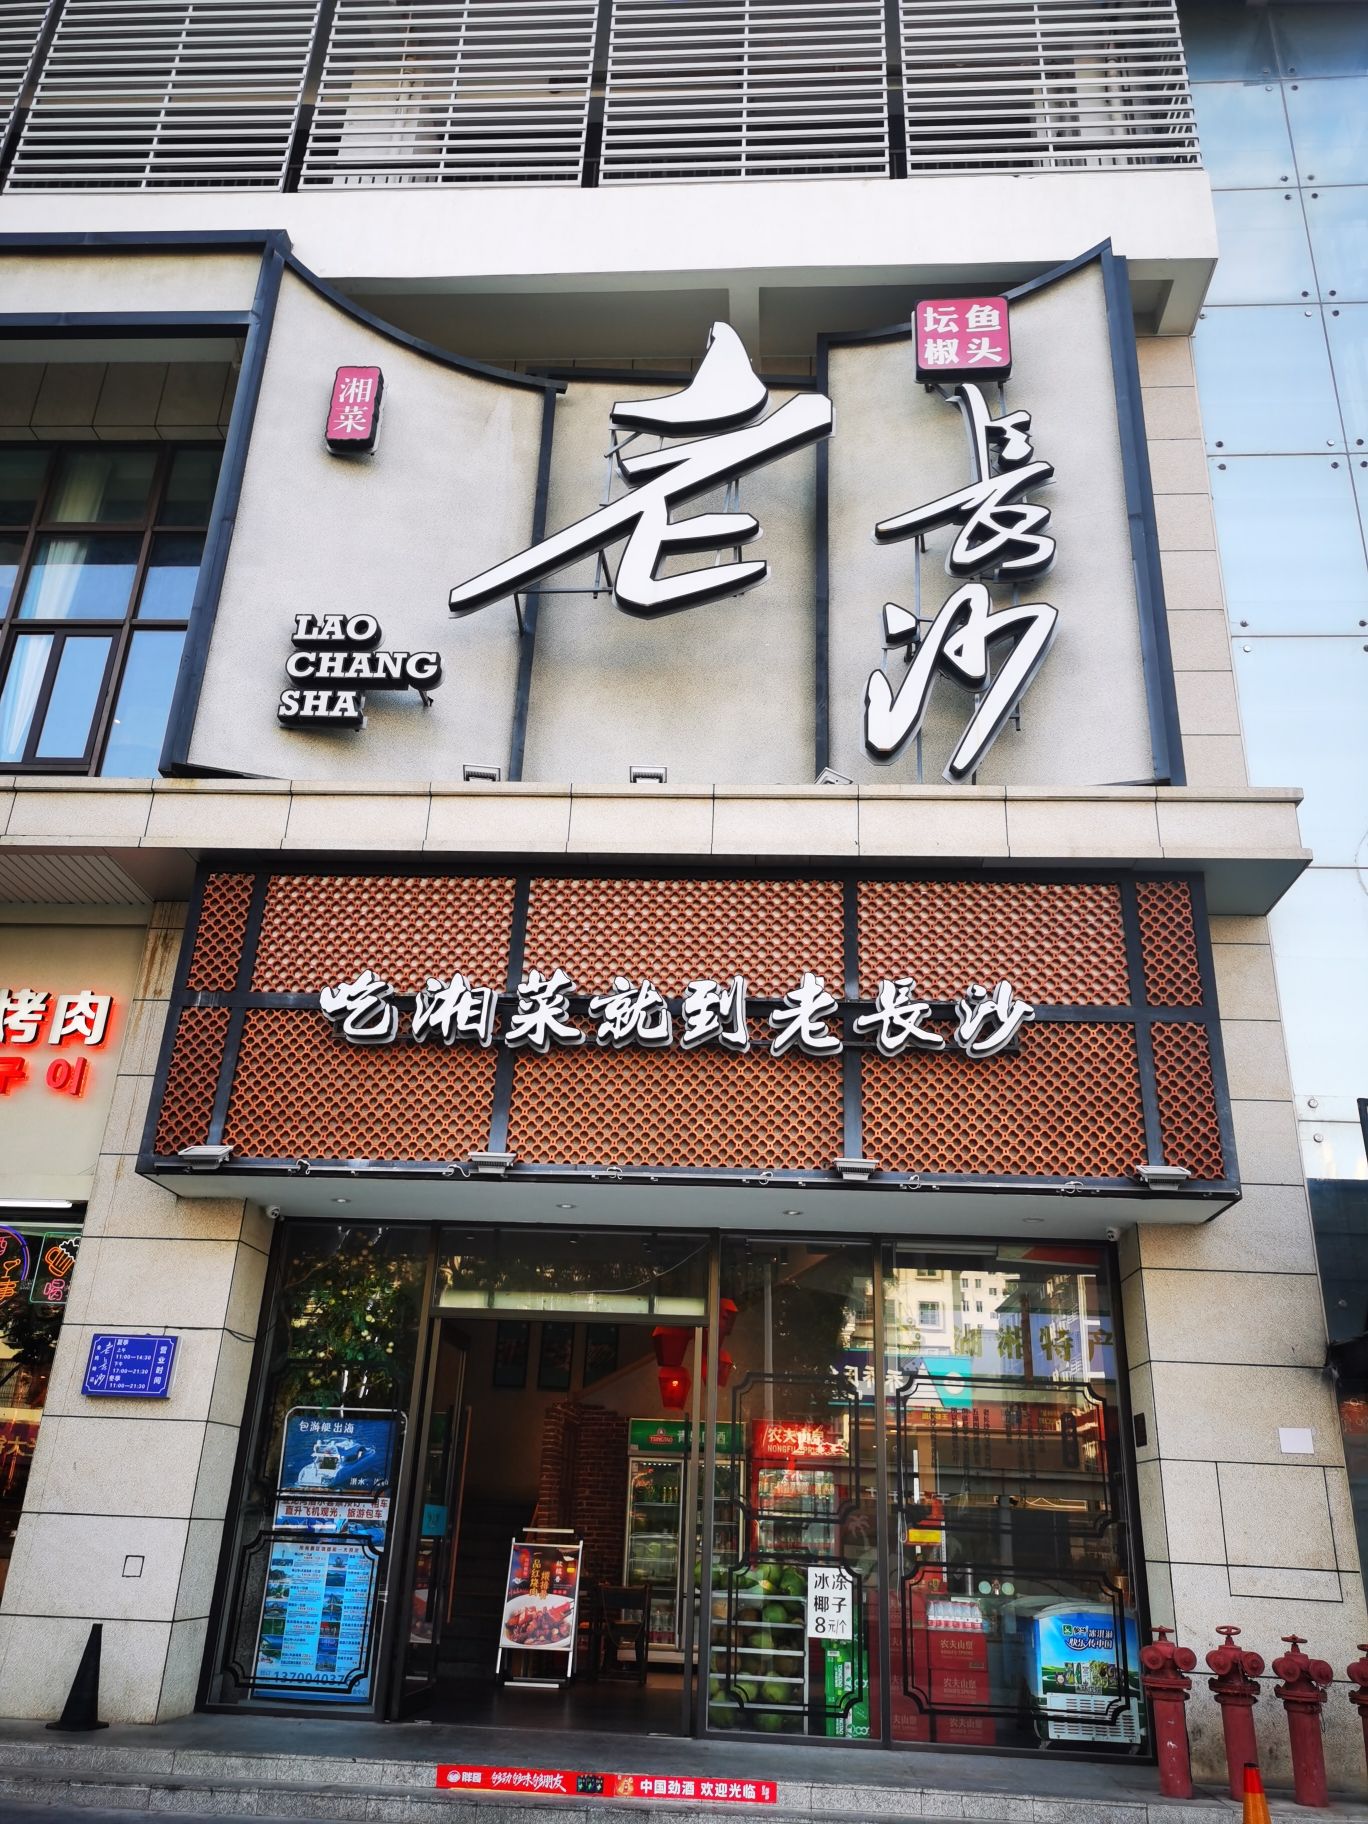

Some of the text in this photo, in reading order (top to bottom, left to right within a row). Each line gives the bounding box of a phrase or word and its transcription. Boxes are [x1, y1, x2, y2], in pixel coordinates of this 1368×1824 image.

[332, 377, 373, 434] 湘菜
[293, 613, 378, 641] LAO
[285, 651, 440, 680] CHANG
[278, 690, 358, 718] SHA
[299, 1420, 355, 1434] 包游艇出海
[767, 1444, 796, 1453] NONGFU
[814, 1573, 848, 1590] 冰冻
[814, 1596, 847, 1613] 椰子
[815, 1616, 847, 1634] 8元/个
[640, 1779, 695, 1796] 中国劲酒
[700, 1782, 756, 1799] 欢迎光临
